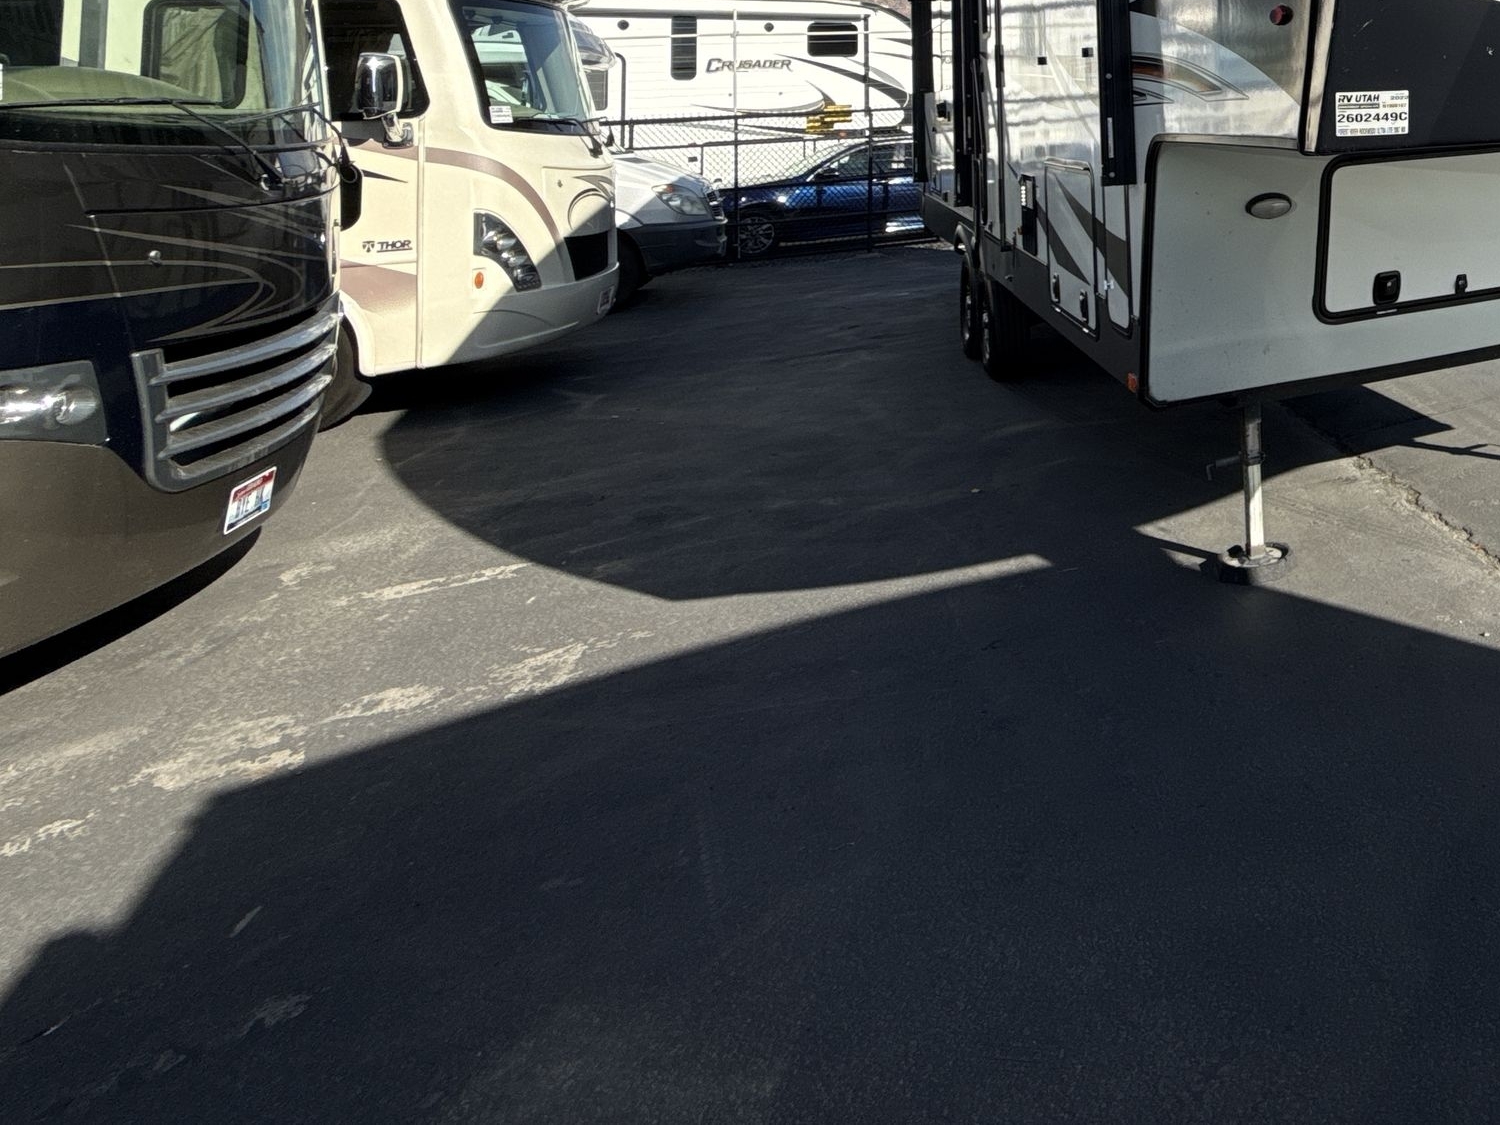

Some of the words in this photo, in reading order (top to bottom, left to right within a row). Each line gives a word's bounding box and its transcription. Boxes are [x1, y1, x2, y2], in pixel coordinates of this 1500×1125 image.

[705, 57, 794, 74] CRUSADER
[1338, 95, 1353, 103] RV
[1355, 94, 1380, 103] UTAH
[1337, 112, 1408, 123] 2602449C
[377, 239, 412, 251] THOR
